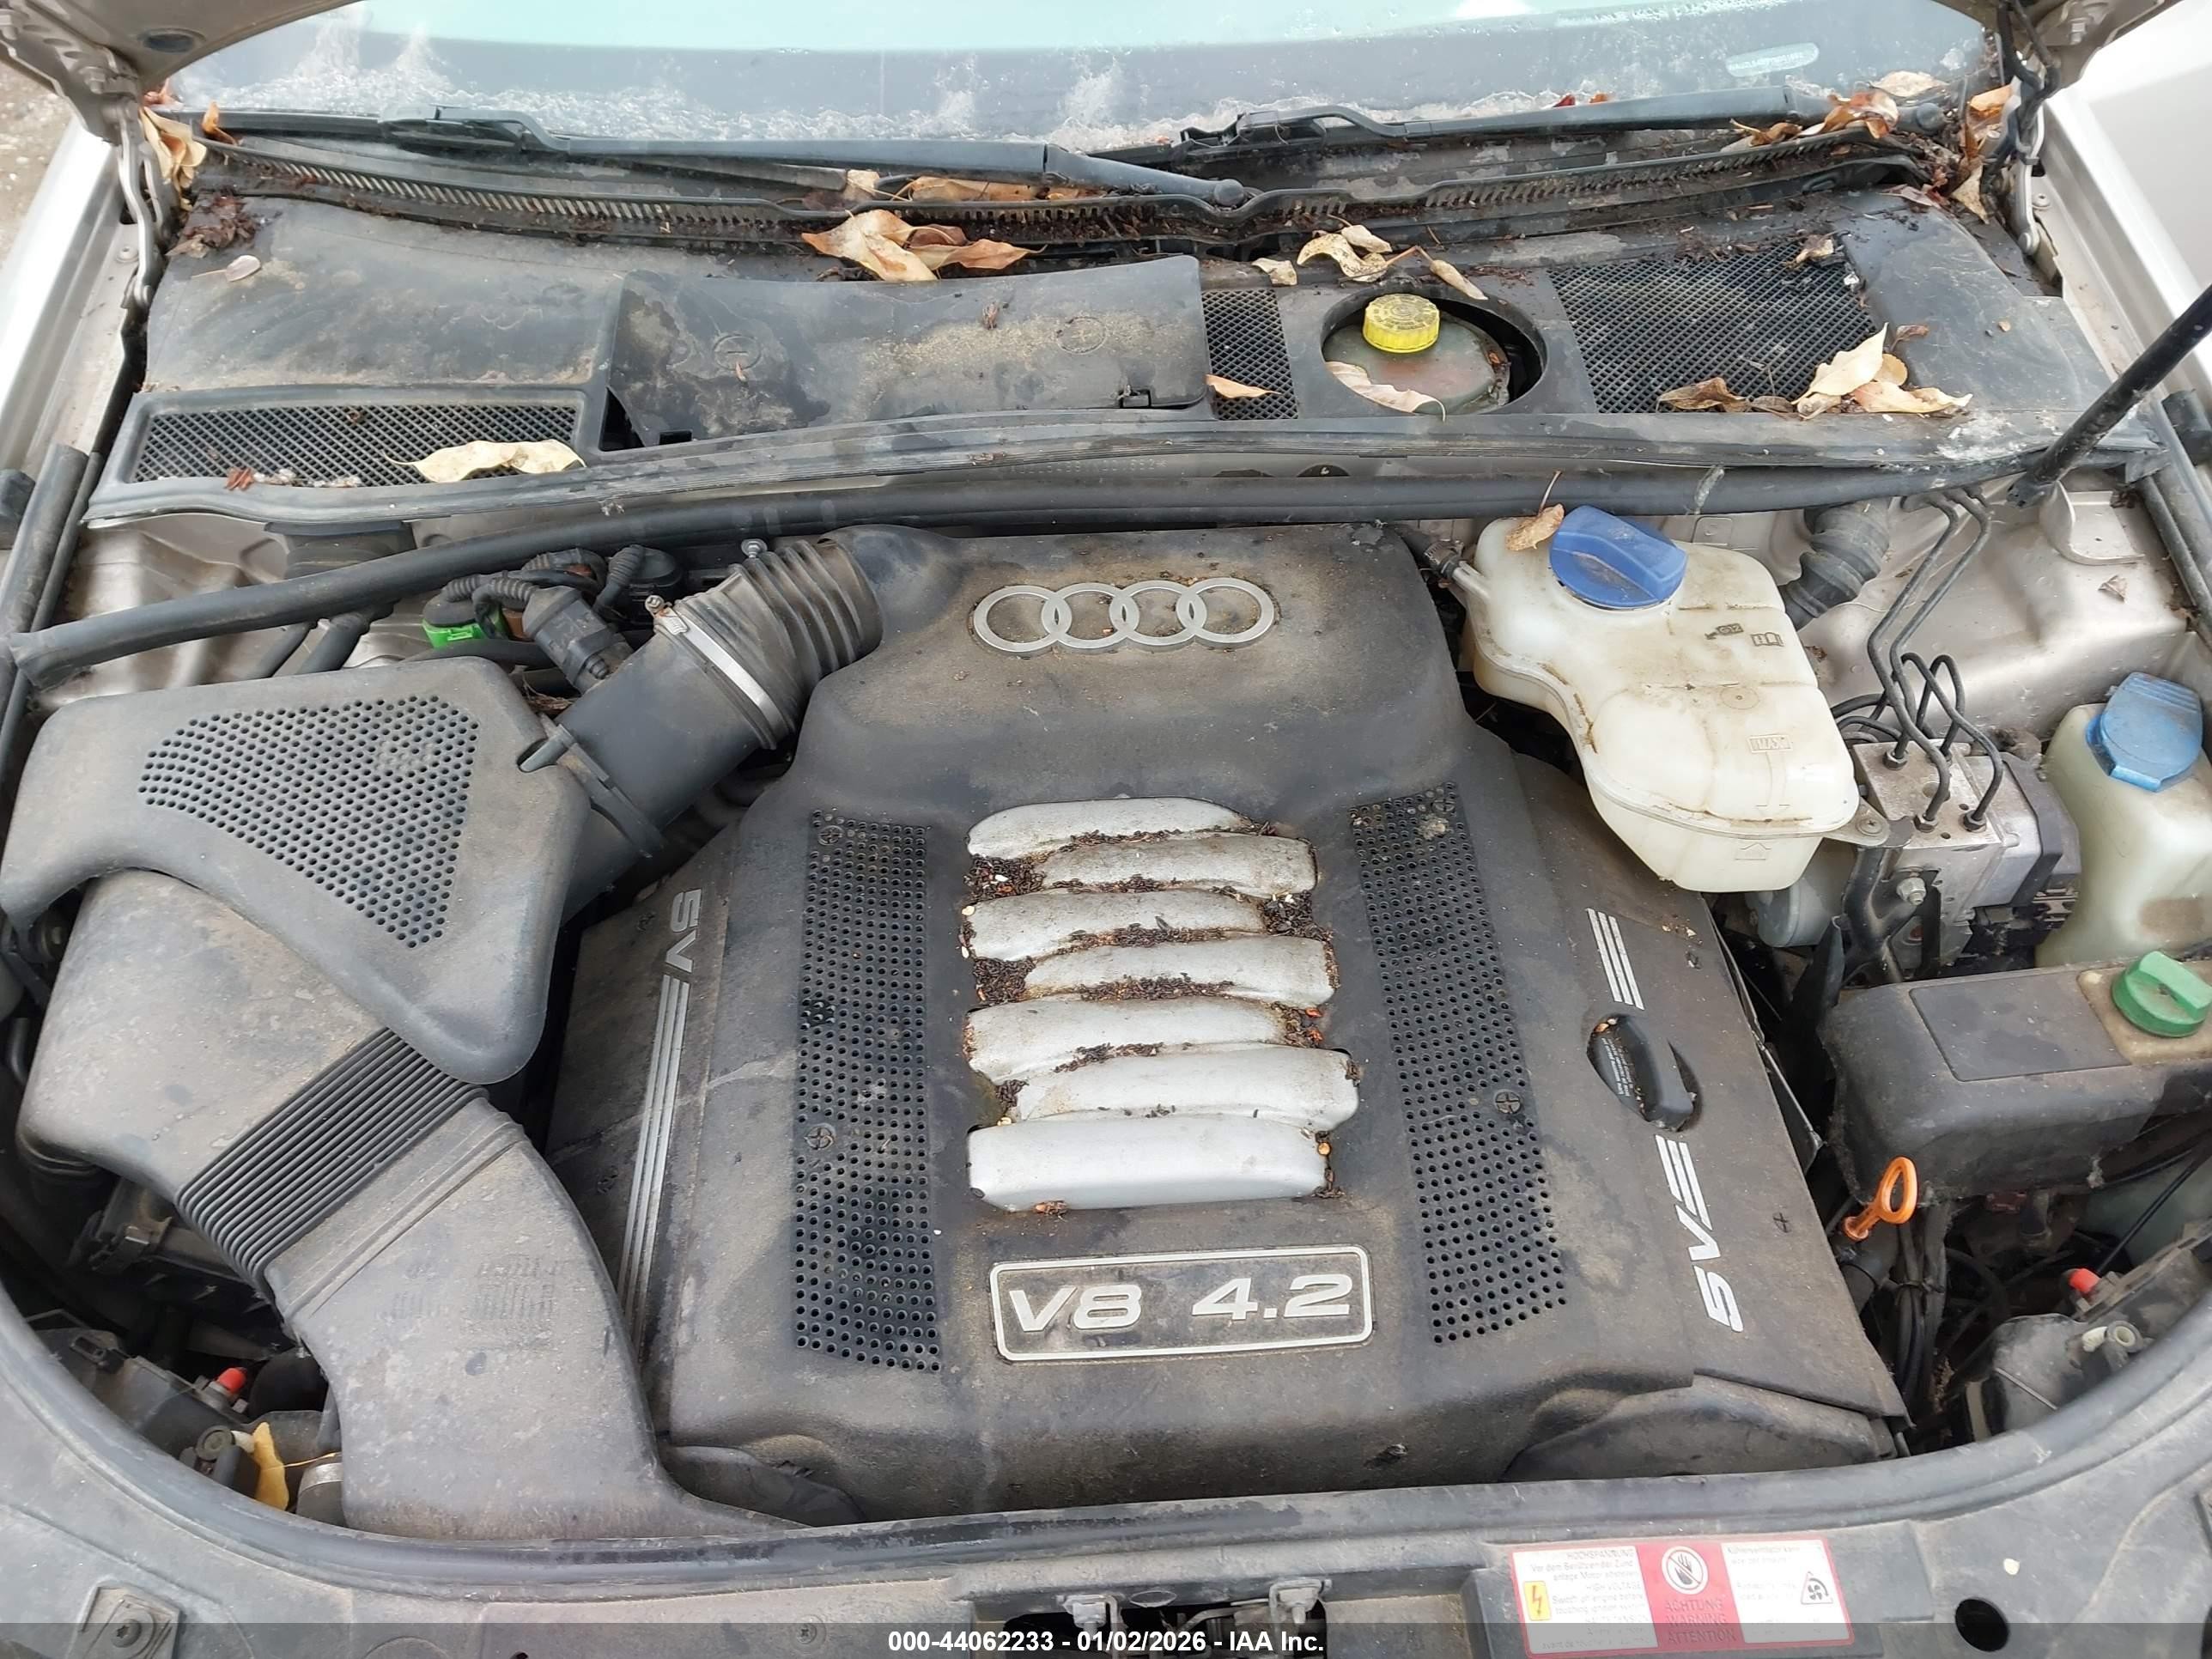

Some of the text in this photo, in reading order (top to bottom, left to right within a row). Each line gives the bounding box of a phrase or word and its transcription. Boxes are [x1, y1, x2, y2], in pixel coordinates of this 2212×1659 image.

[665, 888, 702, 974] 5V
[1675, 1203, 1744, 1333] 5V
[1009, 1273, 1352, 1332] V8 4.2
[1665, 1599, 1723, 1613] ACHTUNG
[1668, 1628, 1737, 1644] ATTENTION
